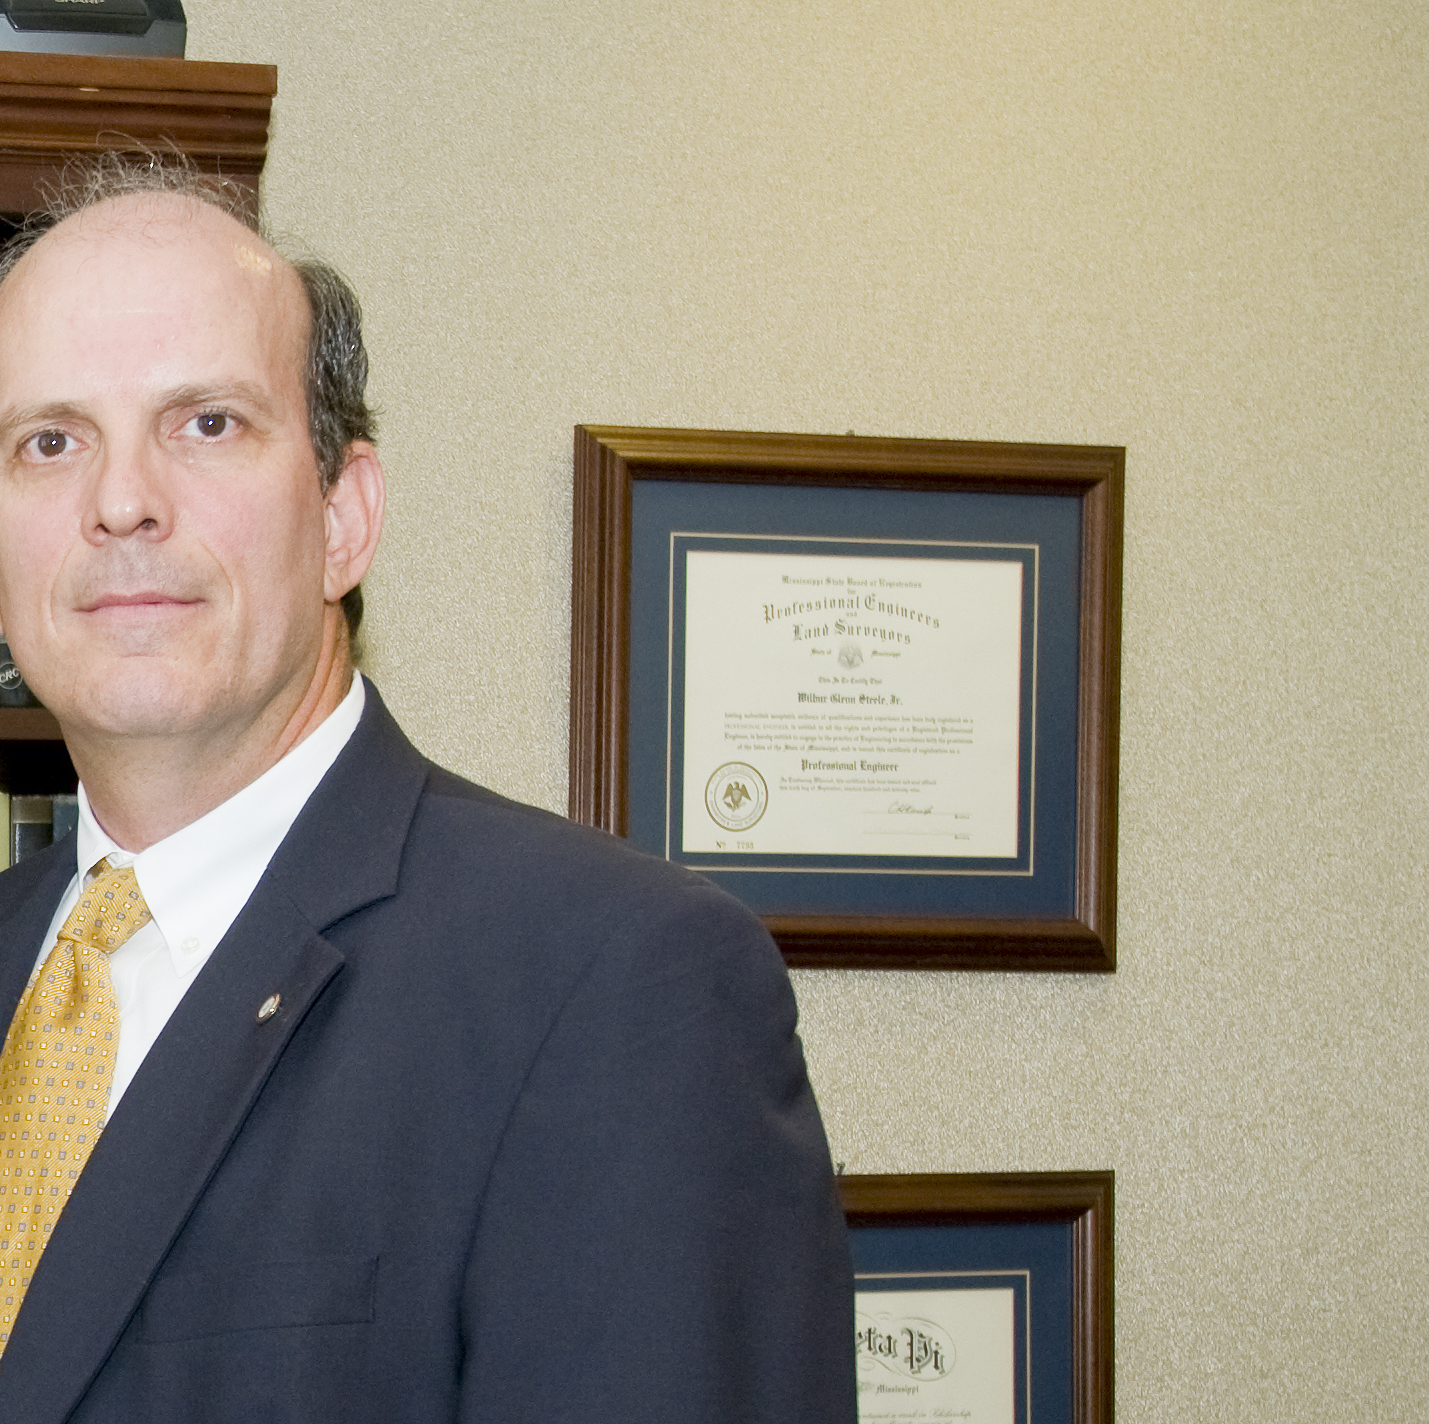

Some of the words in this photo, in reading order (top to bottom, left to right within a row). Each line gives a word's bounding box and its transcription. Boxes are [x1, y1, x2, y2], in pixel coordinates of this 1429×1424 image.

[762, 594, 860, 624] Professional
[864, 593, 940, 629] Engineers
[792, 623, 829, 642] Land
[834, 618, 911, 645] Surveyors
[801, 758, 857, 772] Professional
[859, 759, 899, 773] Engineer
[875, 1384, 919, 1396] Mississippi
